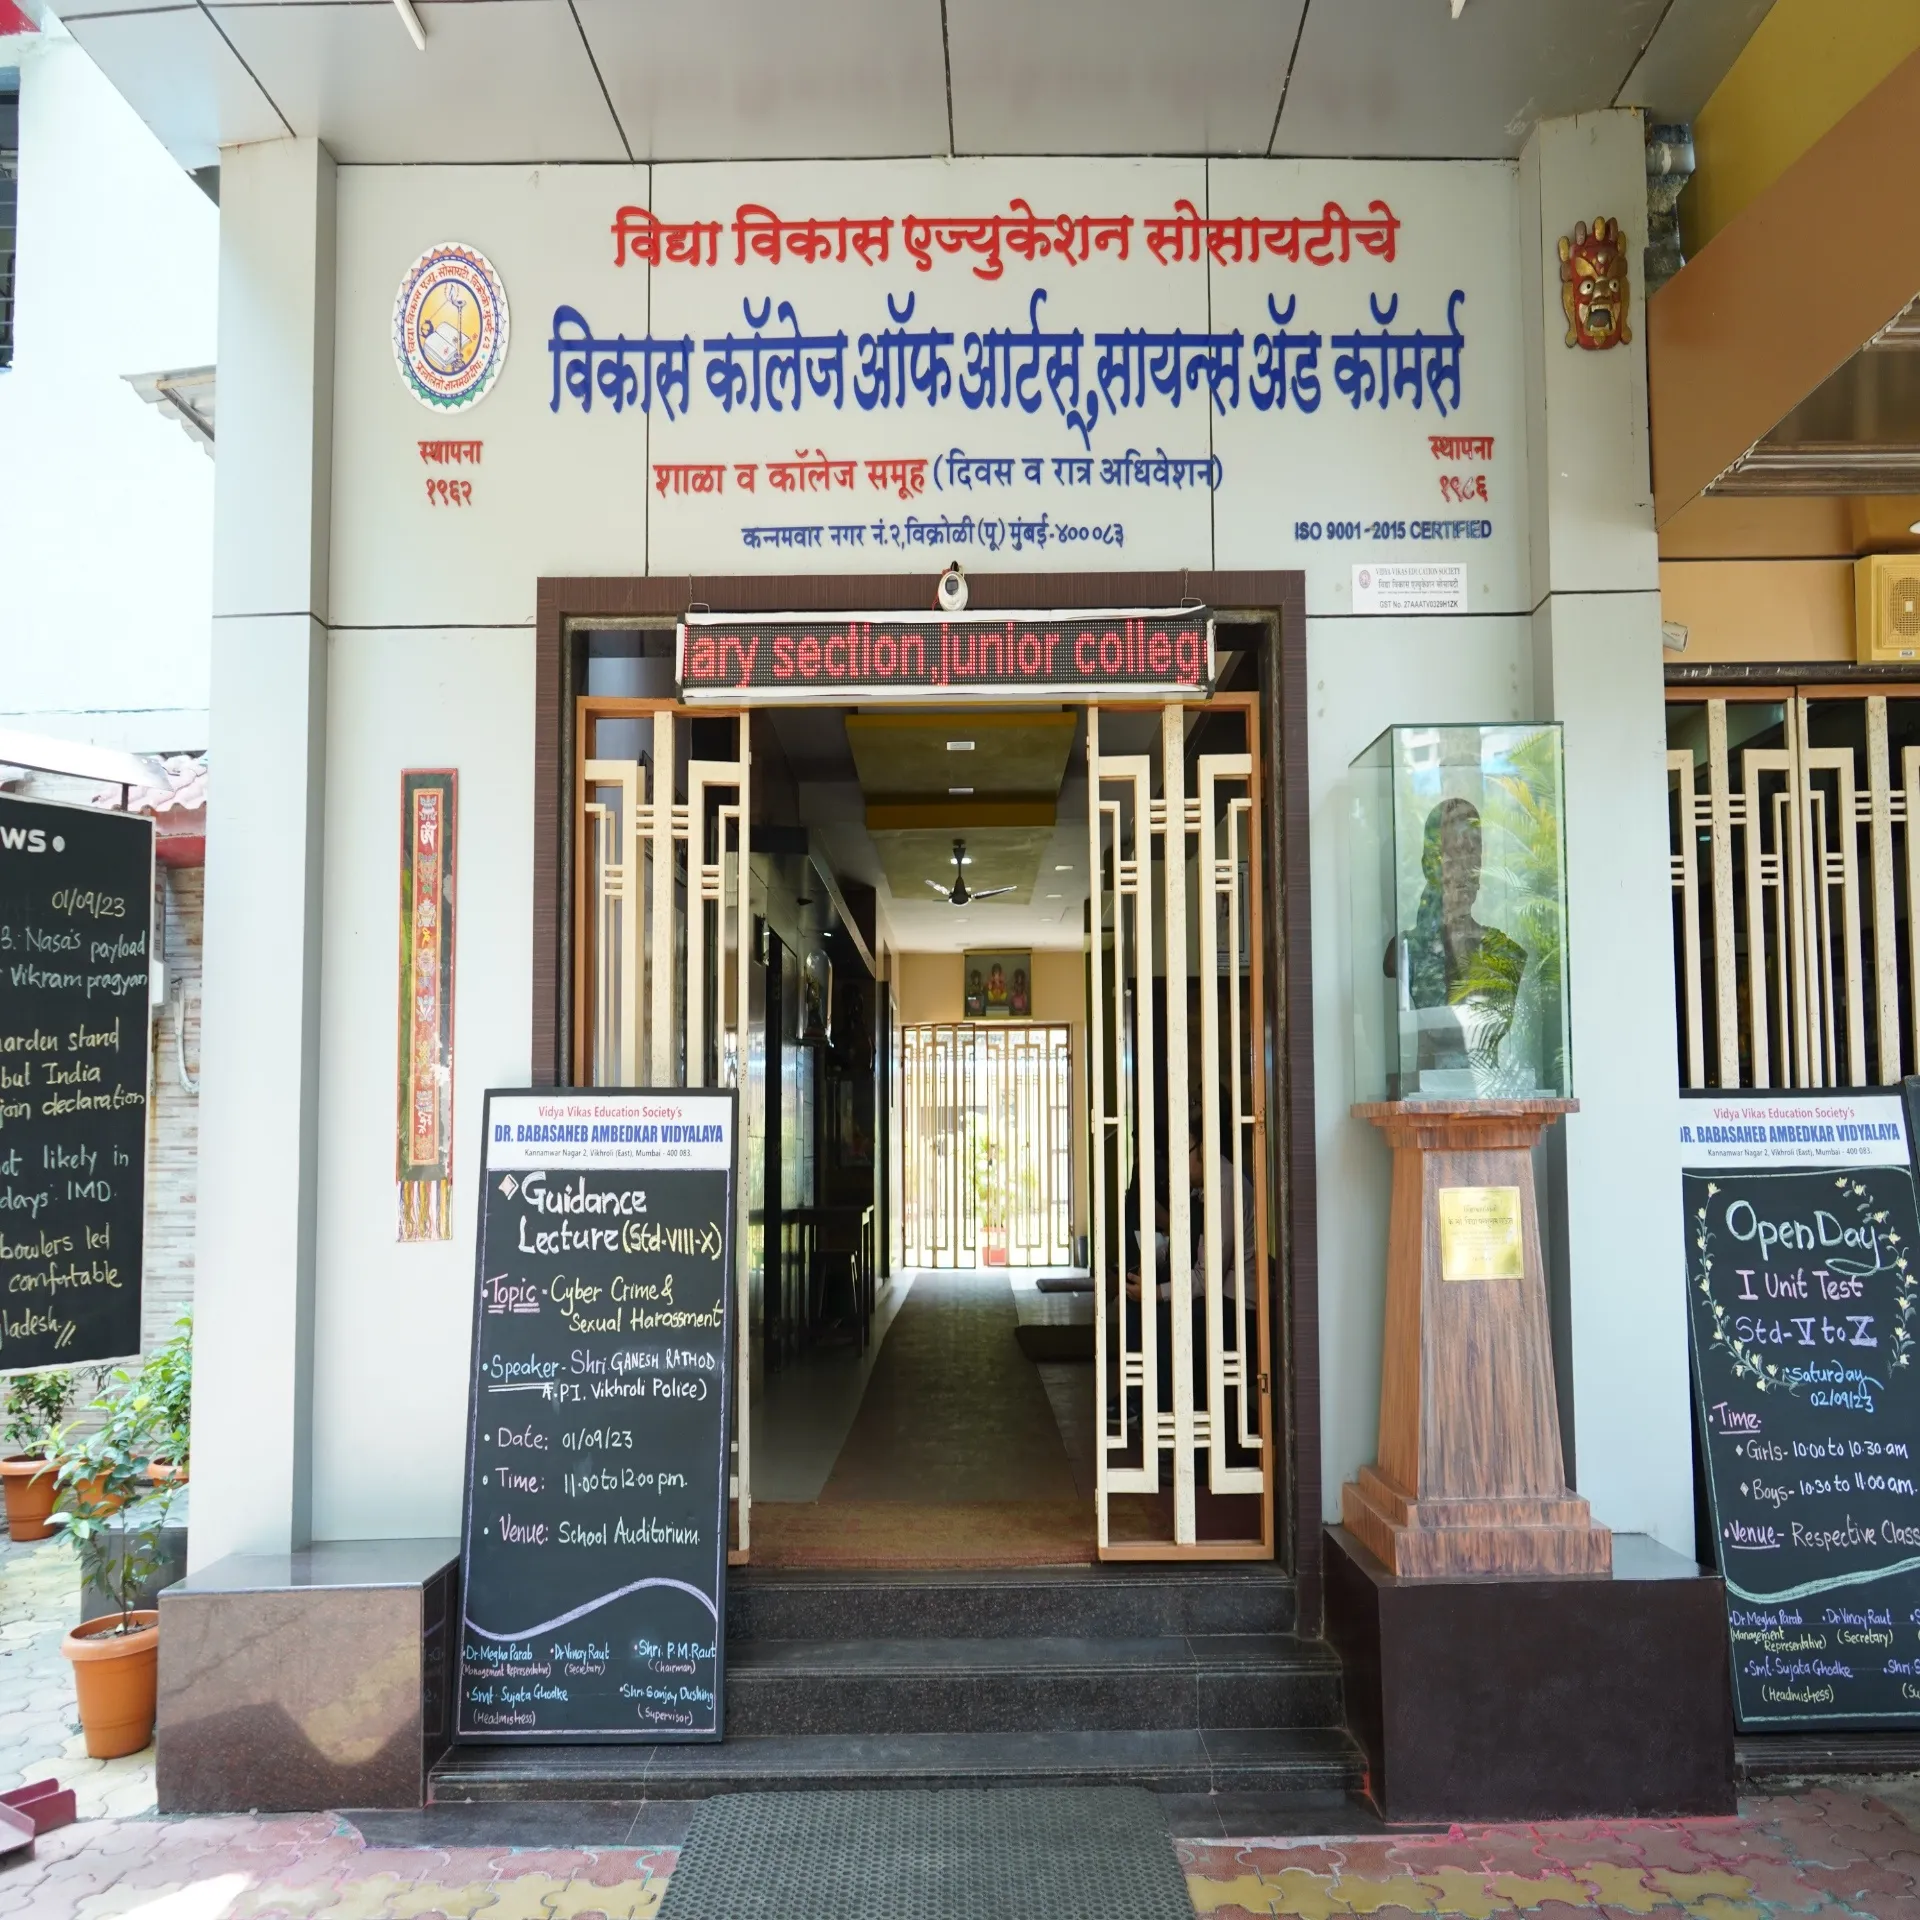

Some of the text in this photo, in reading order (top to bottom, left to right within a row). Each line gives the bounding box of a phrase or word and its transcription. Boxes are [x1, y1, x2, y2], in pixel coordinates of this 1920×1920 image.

[611, 198, 1401, 280] विद्या विकास एज्युकेशन सोसायटीचे
[548, 304, 695, 422] विकास
[704, 296, 848, 413] कॉलेज
[853, 290, 954, 411] ऑफ
[1331, 289, 1465, 418] कॉमर्स
[417, 439, 483, 465] स्थापना
[1428, 436, 1495, 461] स्थापना
[652, 464, 727, 499] शाळा
[734, 463, 759, 494] व
[766, 448, 857, 491] कॉलेज
[864, 458, 928, 501] समूह
[1022, 457, 1045, 486] व
[425, 478, 473, 507] १९६२
[740, 525, 824, 549] कन्नमवार
[828, 524, 866, 547] नगर
[1295, 519, 1493, 541] ISO CERTIFIED
[1439, 567, 1461, 575] SOCIETY
[684, 619, 1208, 688] ary colleg
[52, 888, 126, 919] 01/09/23
[90, 930, 146, 964] payload
[10, 963, 148, 999] Vikram pragyan
[68, 1016, 120, 1053] stand
[41, 1060, 102, 1085] India
[42, 1083, 145, 1117] declaration
[538, 1105, 683, 1120] Vidya Vikas Education Society's
[1714, 1107, 1855, 1121] Vidya Vikas Education Society's
[494, 1124, 723, 1143] DR. BABASAHEB AMBEDKAR VIDYALAYA
[1696, 1123, 1901, 1143] BABASAHEB AMBEDKAR VIDYALAYA
[43, 1143, 130, 1176] likely in
[524, 1149, 561, 1157] Kannamwar
[562, 1149, 582, 1158] Nagar
[590, 1149, 614, 1157] Vikhroli
[615, 1149, 634, 1158] (East),
[635, 1149, 661, 1157] Mumbai
[667, 1149, 679, 1157] 400
[1708, 1149, 1743, 1157] Kannamwar
[1744, 1149, 1763, 1158] Nagar
[1771, 1148, 1795, 1156] Vikhroli
[1795, 1148, 1815, 1157] (East),
[1815, 1148, 1841, 1156] Mumbai
[520, 1170, 648, 1217] Guidance
[0, 1222, 110, 1260] bowlers led
[518, 1216, 619, 1255] Lecture
[1725, 1200, 1815, 1262] Open
[550, 1273, 675, 1316] Cyber Crime &
[1735, 1268, 1865, 1301] I Unit Test
[568, 1307, 622, 1333] Sexual
[1822, 1316, 1846, 1342] to
[610, 1348, 717, 1374] GANESH RATHOD
[591, 1377, 708, 1402] Vikhroli Police)
[1789, 1359, 1884, 1399] Saturday
[1810, 1388, 1875, 1413] 02/09/23
[497, 1424, 634, 1451] Date: 01/09/23
[1828, 1437, 1844, 1457] to
[494, 1466, 546, 1494] Time:
[600, 1468, 619, 1491] to
[1834, 1474, 1850, 1492] to
[499, 1513, 550, 1546] Venue:
[558, 1520, 607, 1546] School
[1791, 1514, 1878, 1551] Respective
[1746, 1611, 1777, 1632] Megha
[1779, 1608, 1803, 1625] Parab
[1867, 1608, 1892, 1625] Raut
[481, 1644, 509, 1668] Megha
[509, 1642, 533, 1660] Parab
[588, 1642, 610, 1660] Raut
[1775, 1655, 1853, 1682] Sujata Ghodke
[500, 1685, 532, 1709] Sujata
[533, 1683, 569, 1702] Ghodke
